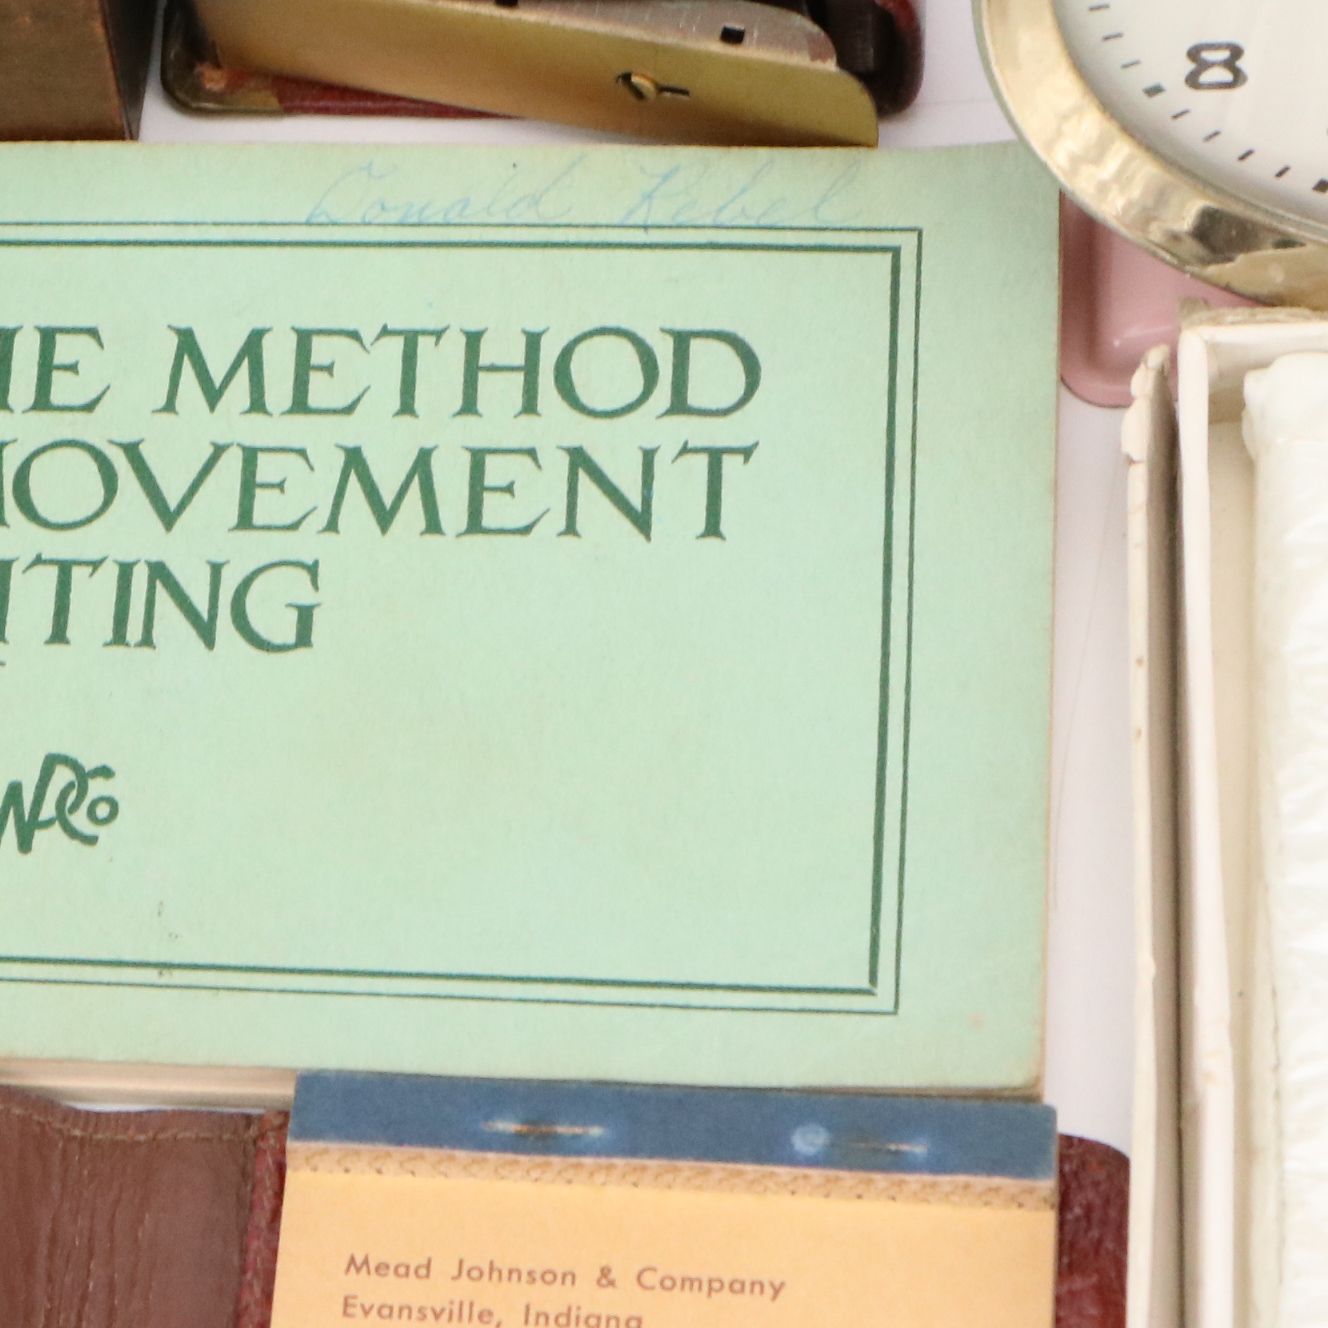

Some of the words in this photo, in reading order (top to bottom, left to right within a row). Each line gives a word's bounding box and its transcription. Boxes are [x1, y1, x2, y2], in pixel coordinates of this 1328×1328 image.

[1184, 41, 1248, 90] 8
[152, 323, 762, 419] METHOD
[345, 1253, 432, 1281] Mead
[451, 1258, 577, 1287] Johnson
[595, 1265, 617, 1288] &
[636, 1266, 787, 1303] Company
[341, 1294, 503, 1328] Evansville,
[522, 1302, 644, 1328] Indiana
